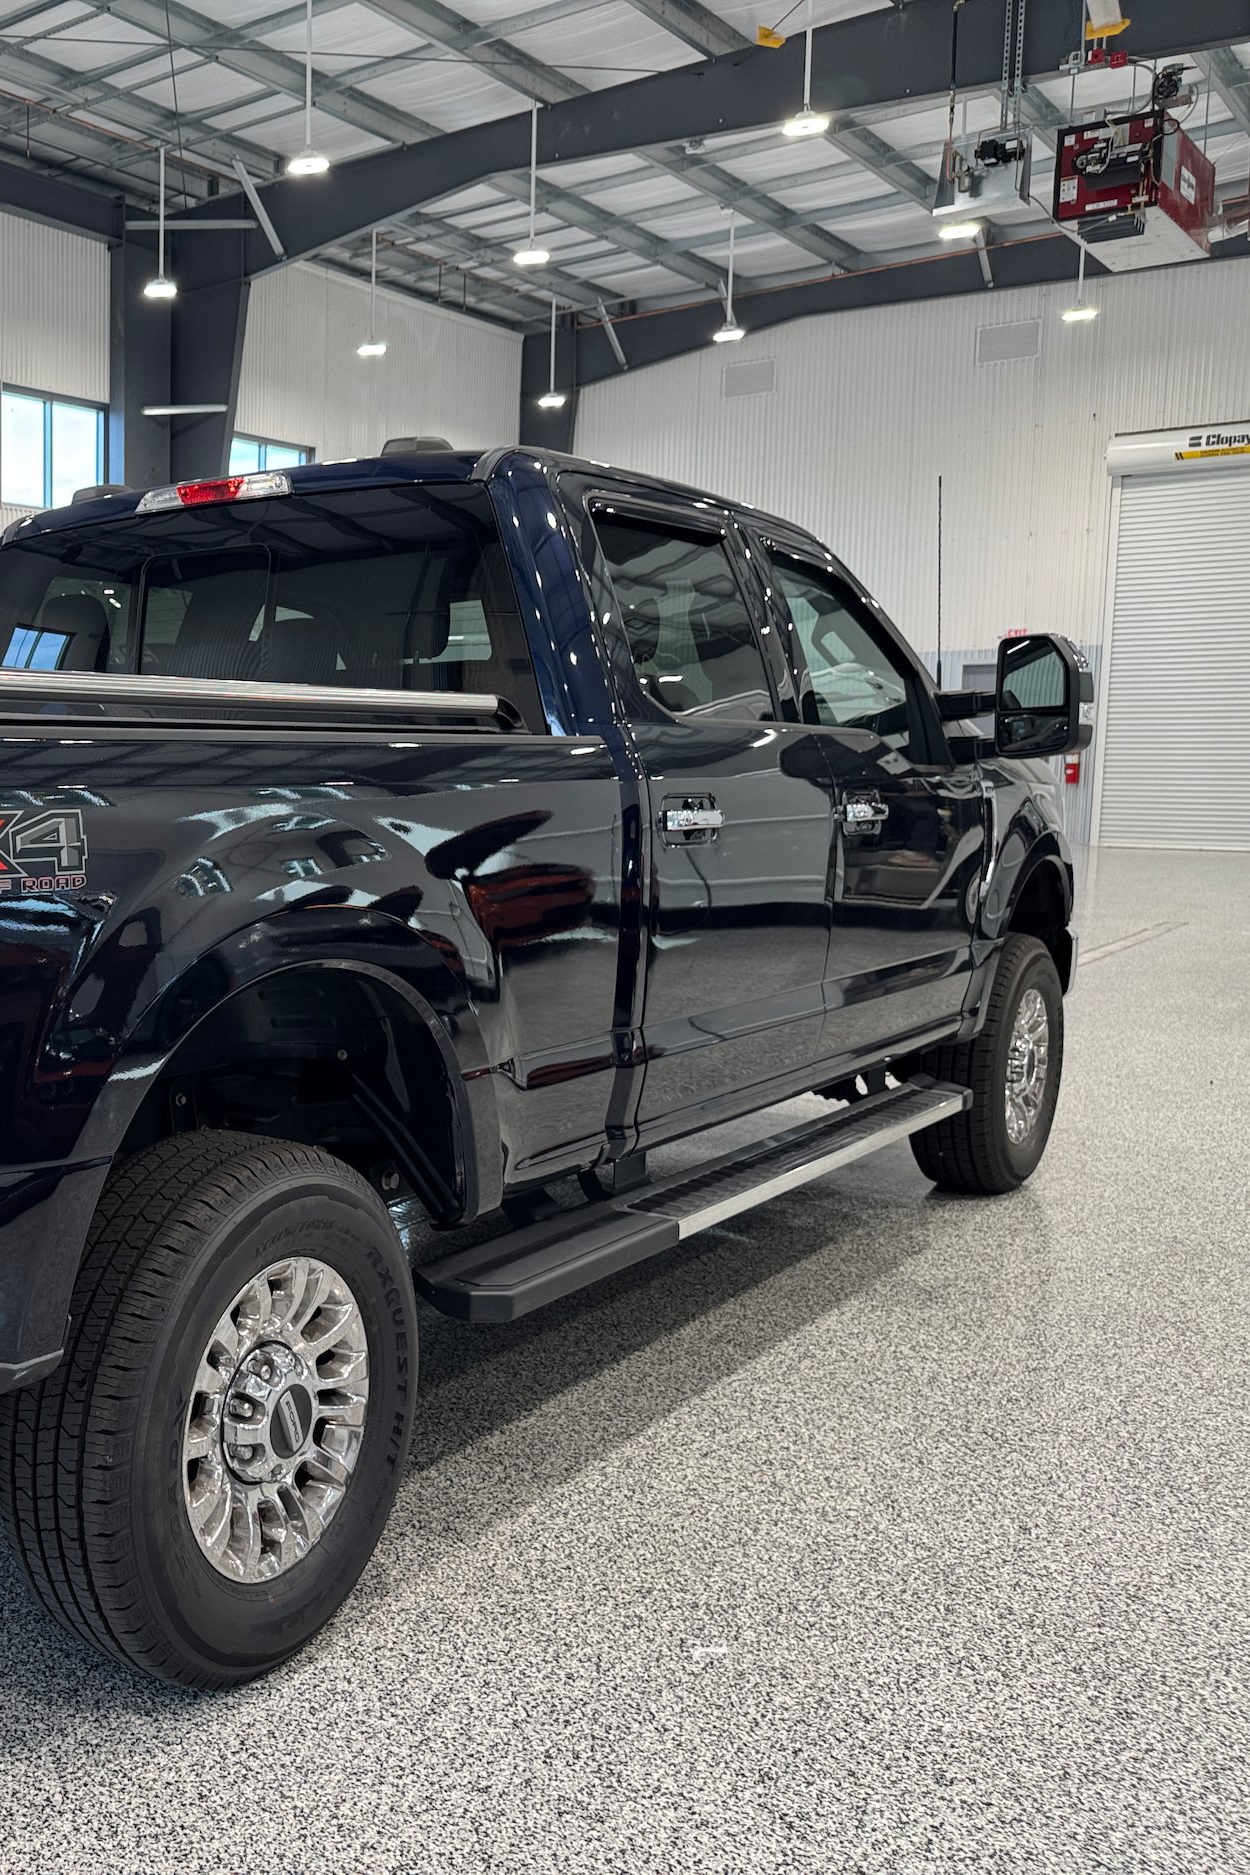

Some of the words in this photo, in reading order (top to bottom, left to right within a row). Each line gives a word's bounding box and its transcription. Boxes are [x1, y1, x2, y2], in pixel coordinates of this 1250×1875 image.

[1205, 433, 1250, 447] Clopay
[20, 874, 87, 893] ROAD
[285, 1400, 300, 1444] FORD
